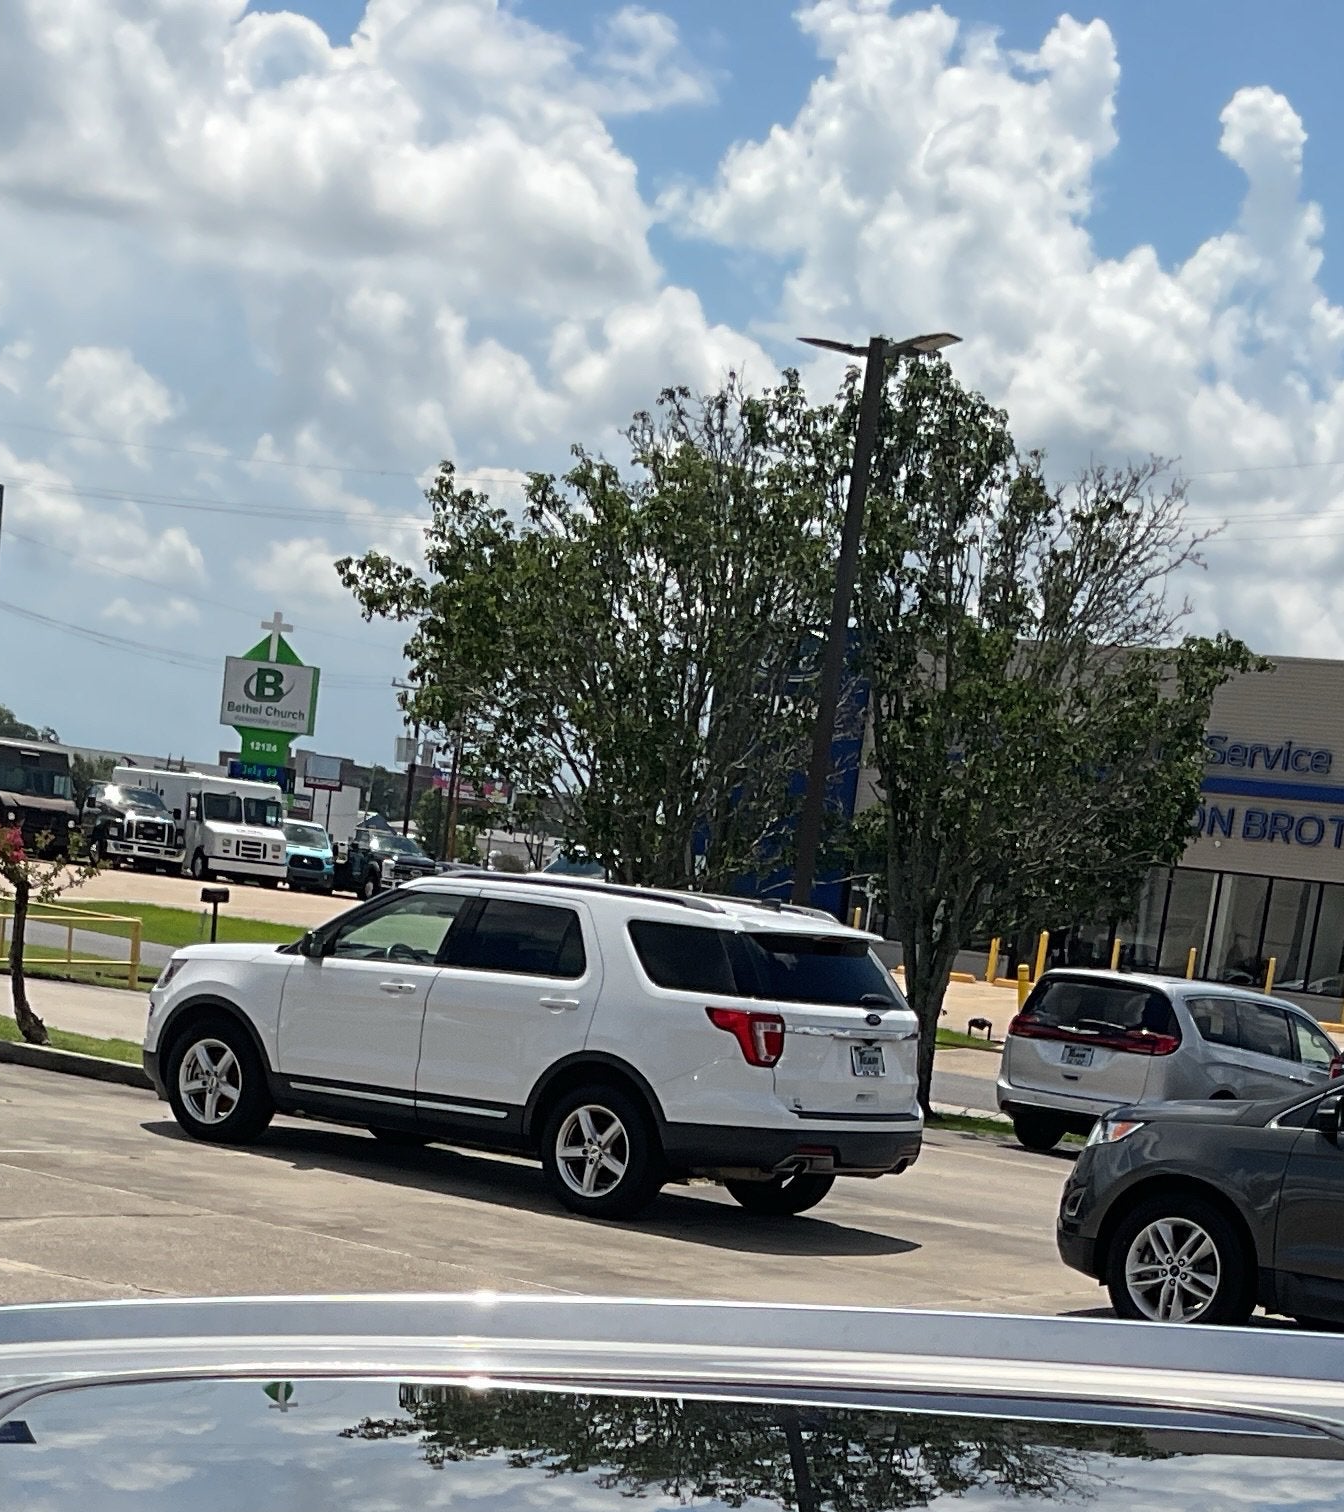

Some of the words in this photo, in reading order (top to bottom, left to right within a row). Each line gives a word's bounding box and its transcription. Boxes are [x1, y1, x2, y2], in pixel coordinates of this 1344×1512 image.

[227, 701, 262, 714] Bethel
[265, 706, 305, 721] Church
[1206, 735, 1332, 774] Service
